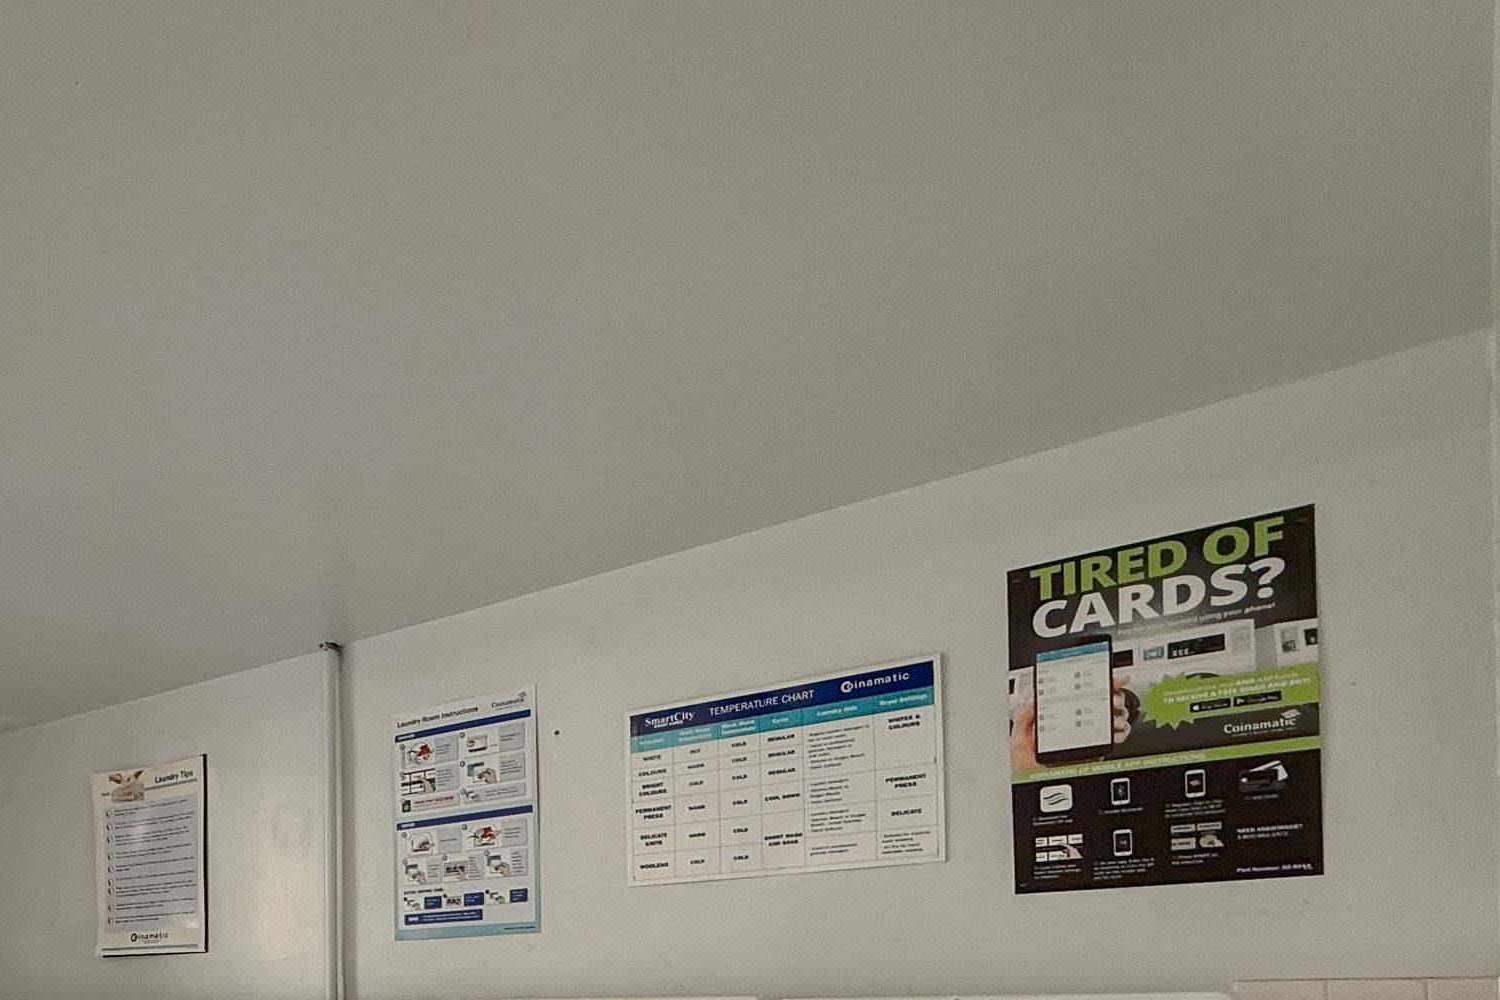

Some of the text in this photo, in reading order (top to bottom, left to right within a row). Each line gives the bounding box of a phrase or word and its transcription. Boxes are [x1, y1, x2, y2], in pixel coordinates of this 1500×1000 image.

[1030, 516, 1284, 600] TIRED OF
[1032, 556, 1286, 638] CARDS?
[708, 690, 815, 717] TEMPERATURE CHART
[397, 706, 478, 728] Laundry Room Instructions
[644, 710, 694, 728] SmartCity
[888, 720, 920, 730] COLOURS
[1223, 717, 1297, 734] Coinamatic
[767, 734, 795, 742] REGULAR
[768, 750, 796, 758] REGULAR
[731, 756, 747, 764] COLD
[154, 770, 194, 784] Laundry Tips
[638, 768, 667, 777] COLOURS
[885, 773, 926, 784] PERMANENT
[635, 805, 672, 814] PERMANENT
[890, 808, 922, 816] DELICATE
[640, 832, 668, 840] DELICATE
[640, 862, 669, 870] WOOLENS
